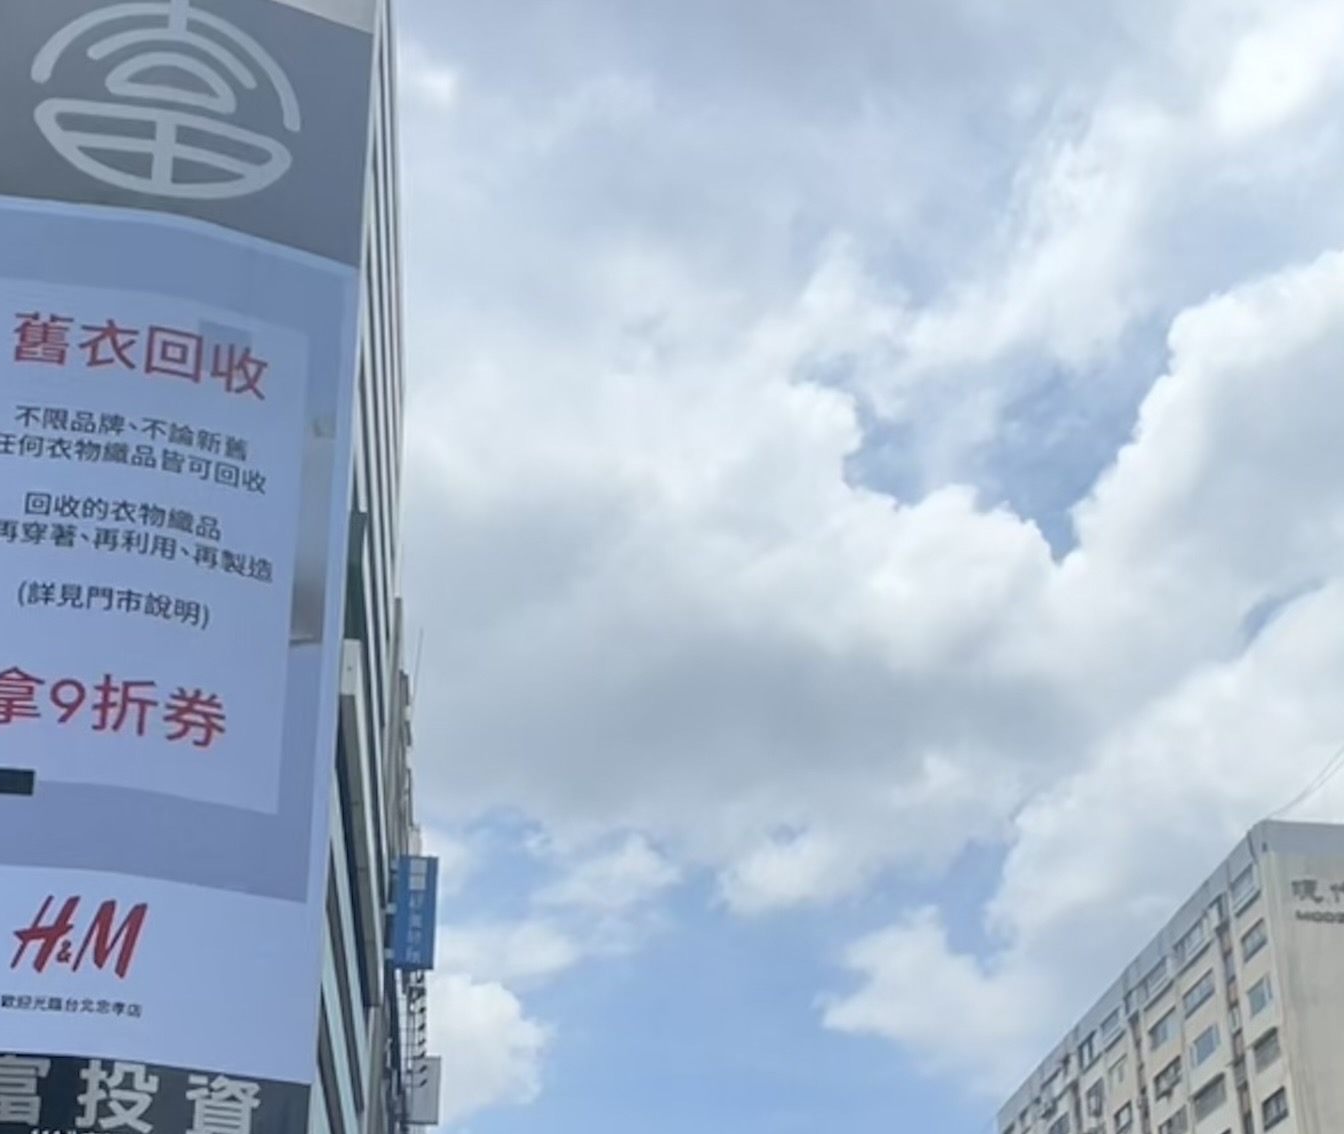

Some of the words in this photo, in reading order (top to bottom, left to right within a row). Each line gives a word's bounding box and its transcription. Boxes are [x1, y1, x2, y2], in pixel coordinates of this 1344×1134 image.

[11, 311, 270, 401] 舊衣回收
[22, 491, 223, 541] 回收的衣物織品
[9, 894, 149, 981] H&M
